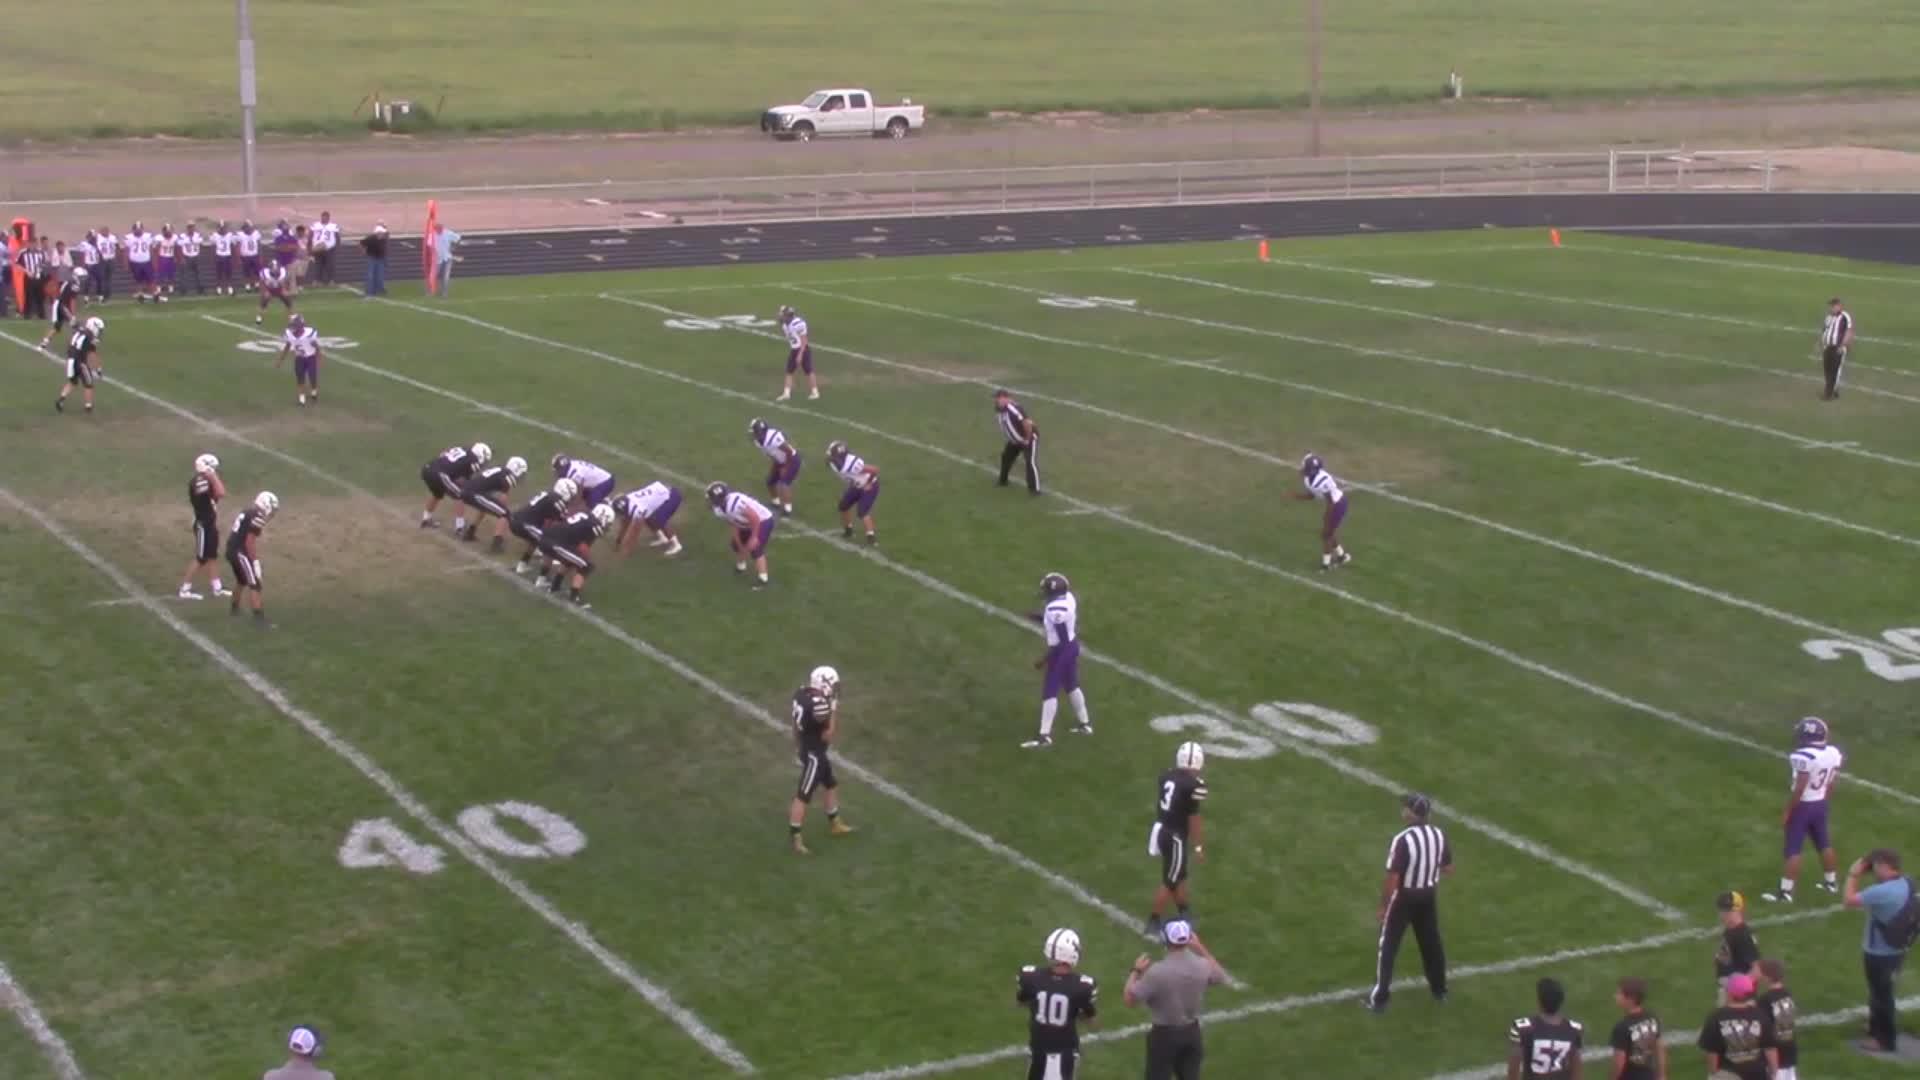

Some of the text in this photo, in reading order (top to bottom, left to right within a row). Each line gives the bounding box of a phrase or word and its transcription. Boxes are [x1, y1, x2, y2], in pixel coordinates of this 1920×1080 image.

[1150, 701, 1380, 759] 30
[1160, 780, 1176, 811] 3
[338, 800, 587, 874] 40
[1035, 991, 1070, 1027] 10
[1531, 1039, 1571, 1074] 57
